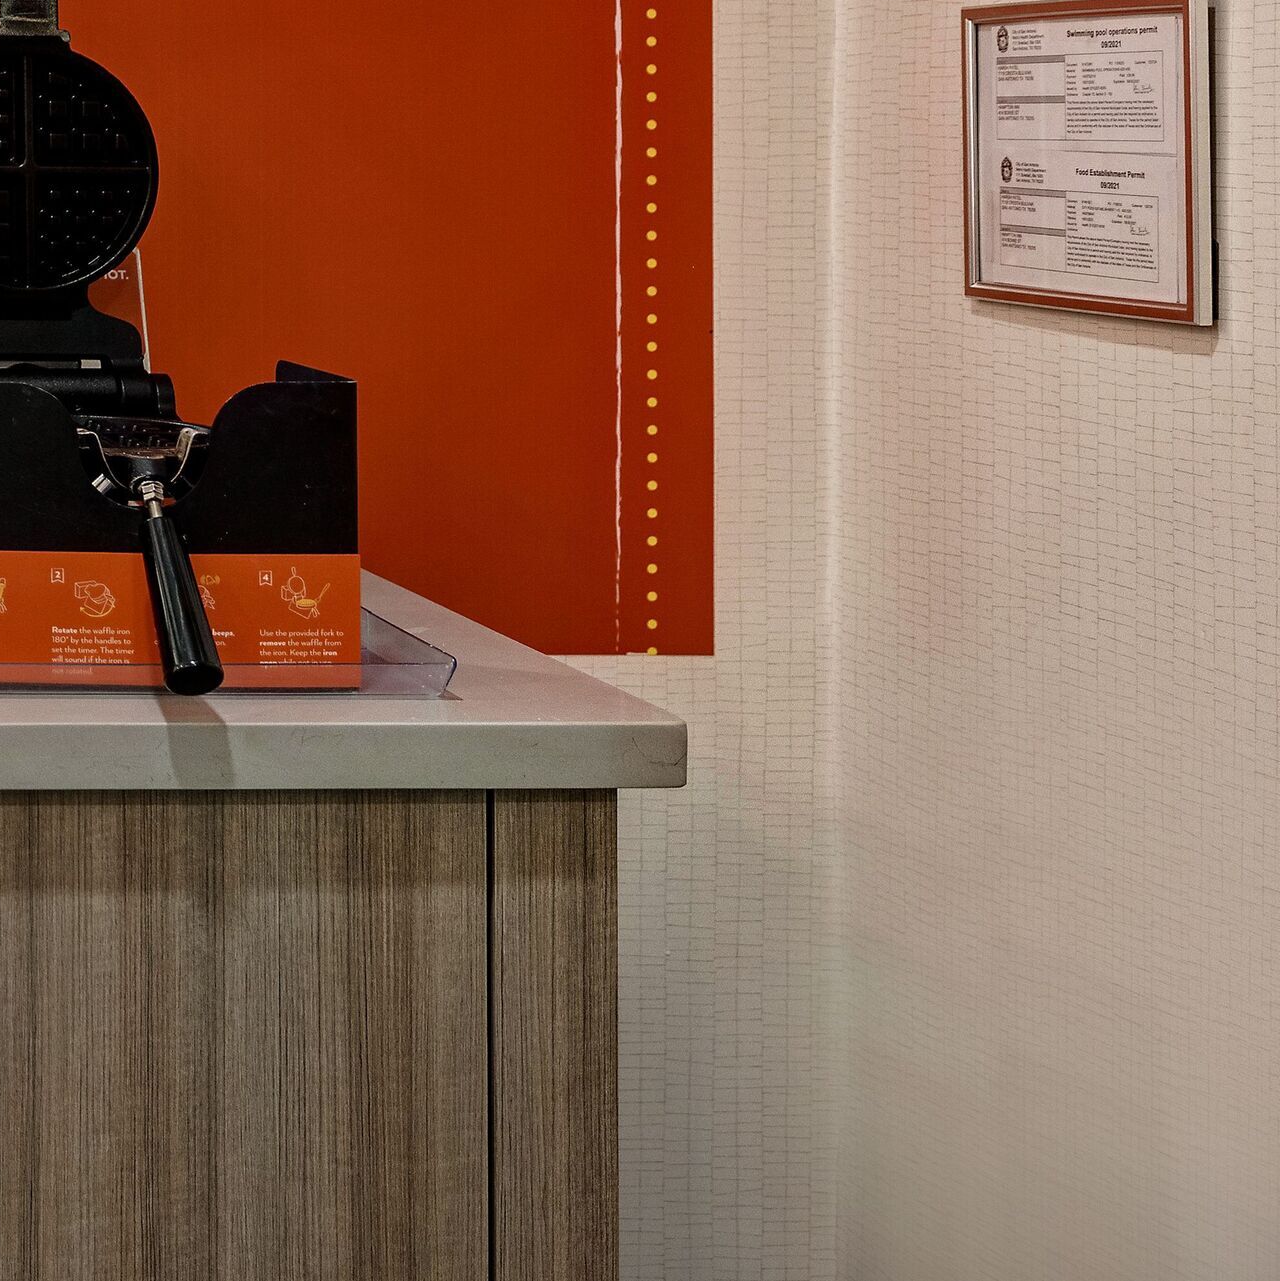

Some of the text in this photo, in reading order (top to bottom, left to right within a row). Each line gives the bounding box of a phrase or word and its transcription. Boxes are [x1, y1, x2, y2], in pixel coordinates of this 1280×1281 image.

[1066, 26, 1158, 38] Swimming pool operations permit
[1075, 168, 1145, 179] Food Establishment Permit
[52, 626, 77, 634] Rotate
[70, 636, 79, 645] by
[94, 637, 122, 645] handles
[78, 646, 98, 654] timer.
[100, 646, 114, 654] The
[116, 647, 135, 655] timer
